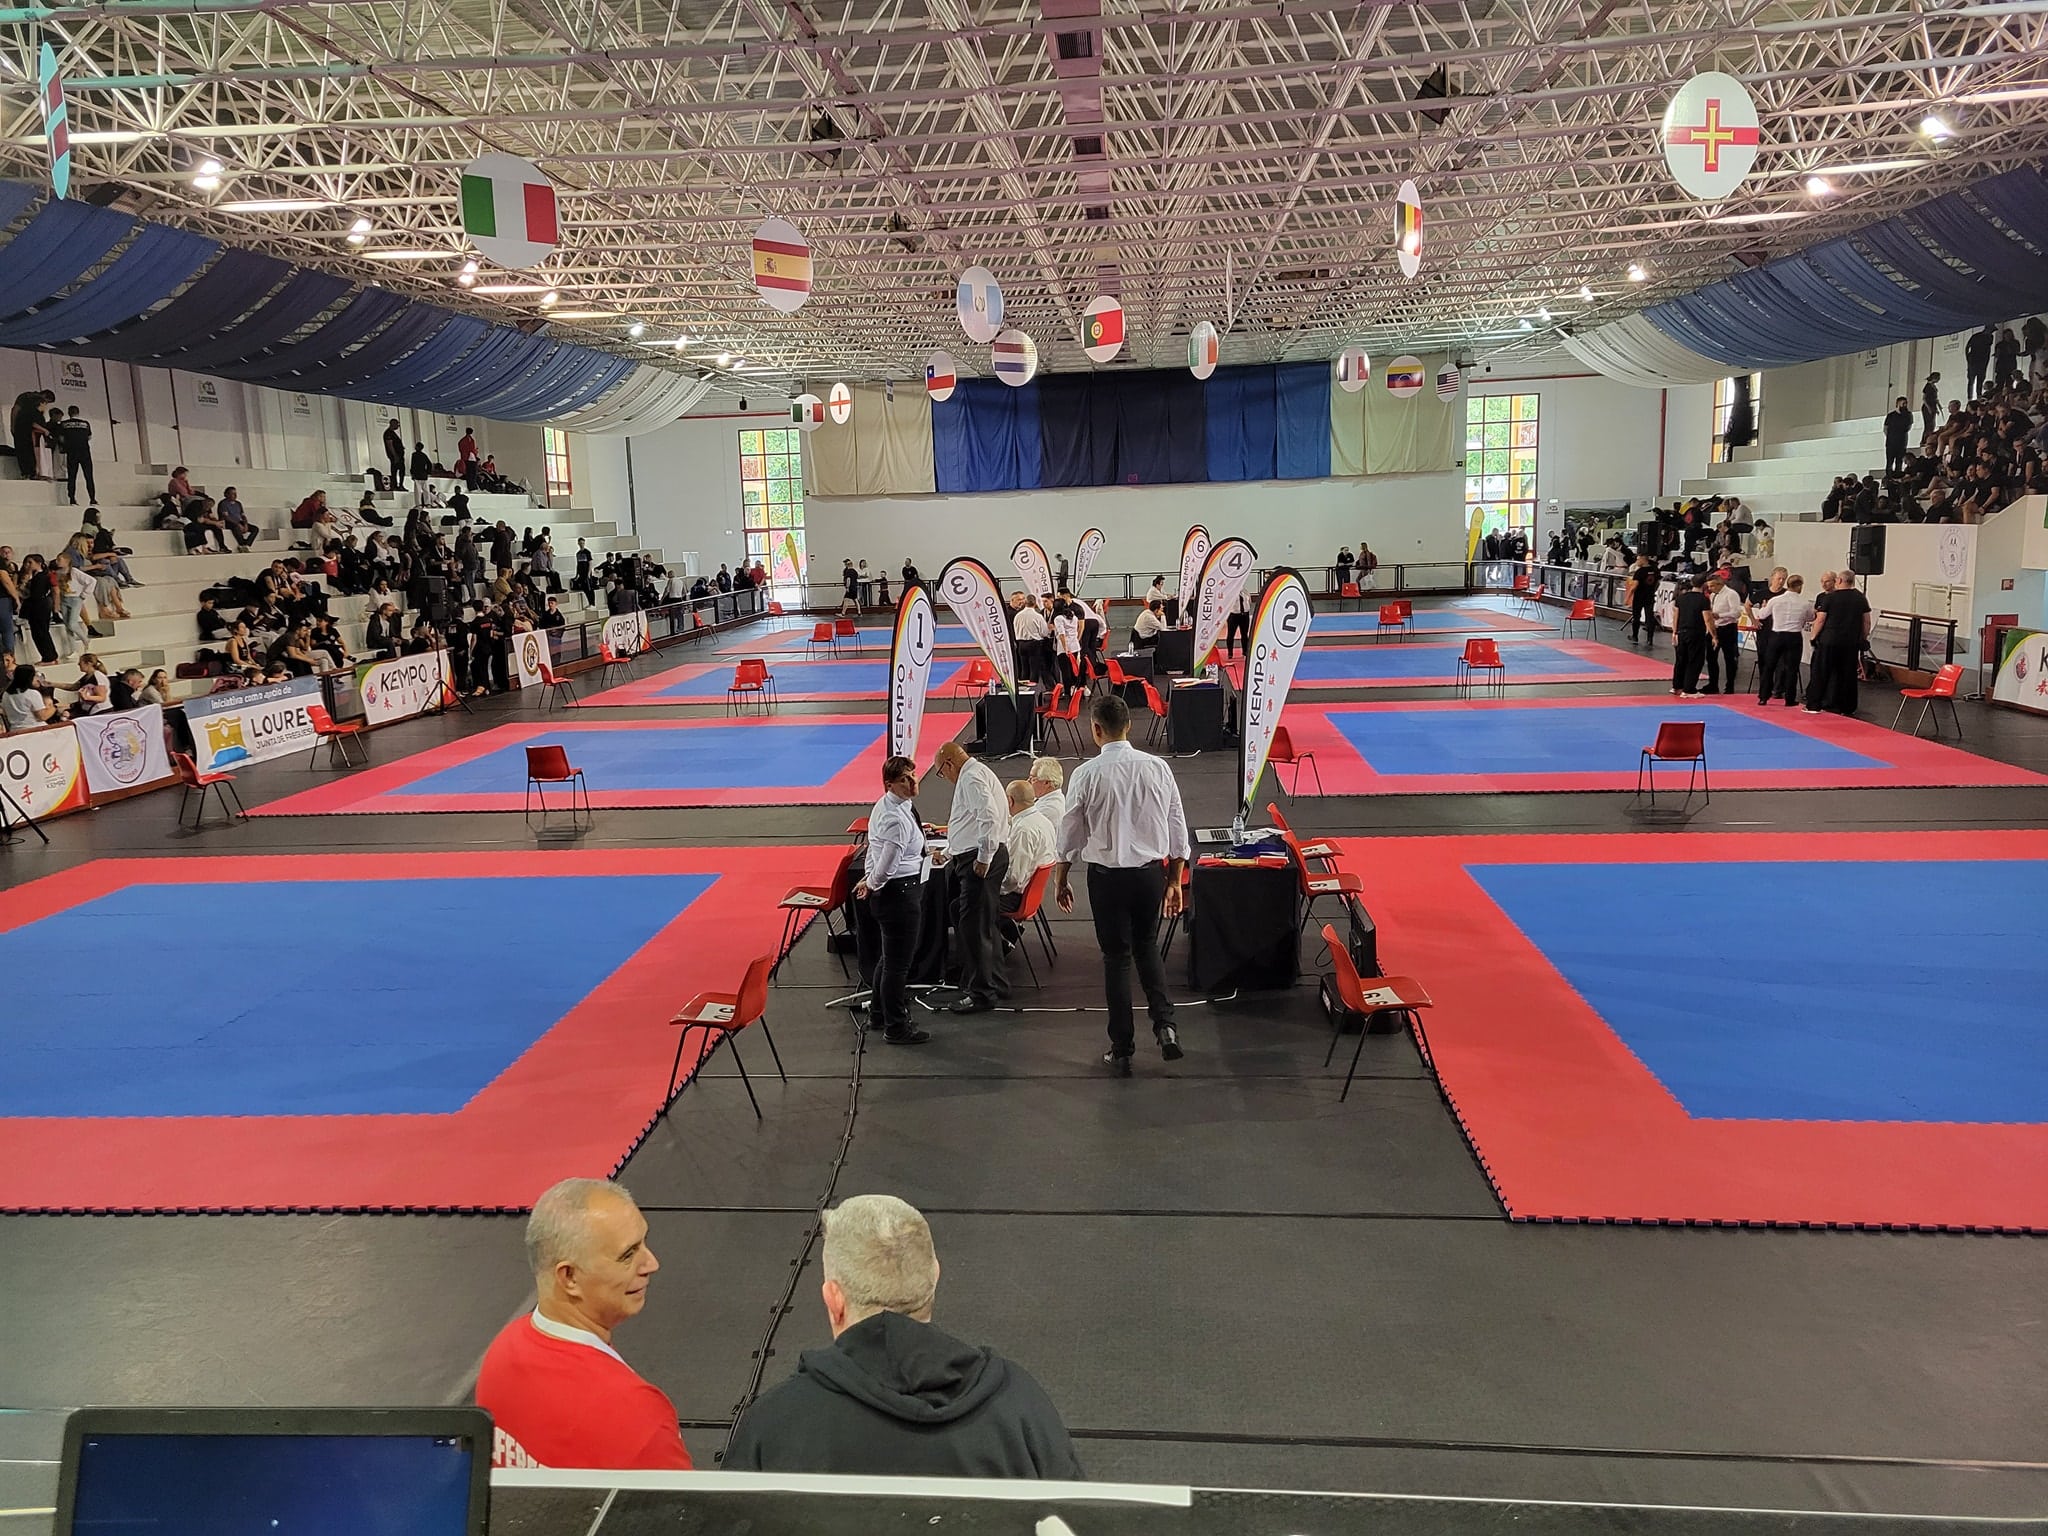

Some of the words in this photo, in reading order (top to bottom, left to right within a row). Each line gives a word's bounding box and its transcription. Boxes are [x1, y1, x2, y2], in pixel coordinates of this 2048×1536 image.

[1093, 536, 1100, 546] 7
[1196, 540, 1205, 553] 6
[1183, 555, 1191, 587] KEMPO
[1228, 552, 1243, 570] 4
[1202, 578, 1216, 621] KEMPO
[611, 619, 636, 638] KEMPO
[916, 612, 925, 649] 1
[1282, 600, 1299, 633] 2
[283, 685, 292, 695] de
[381, 663, 428, 693] KEMPO
[1249, 643, 1267, 727] KEMPO
[251, 707, 312, 738] LOURE
[896, 664, 906, 756] KEMPO
